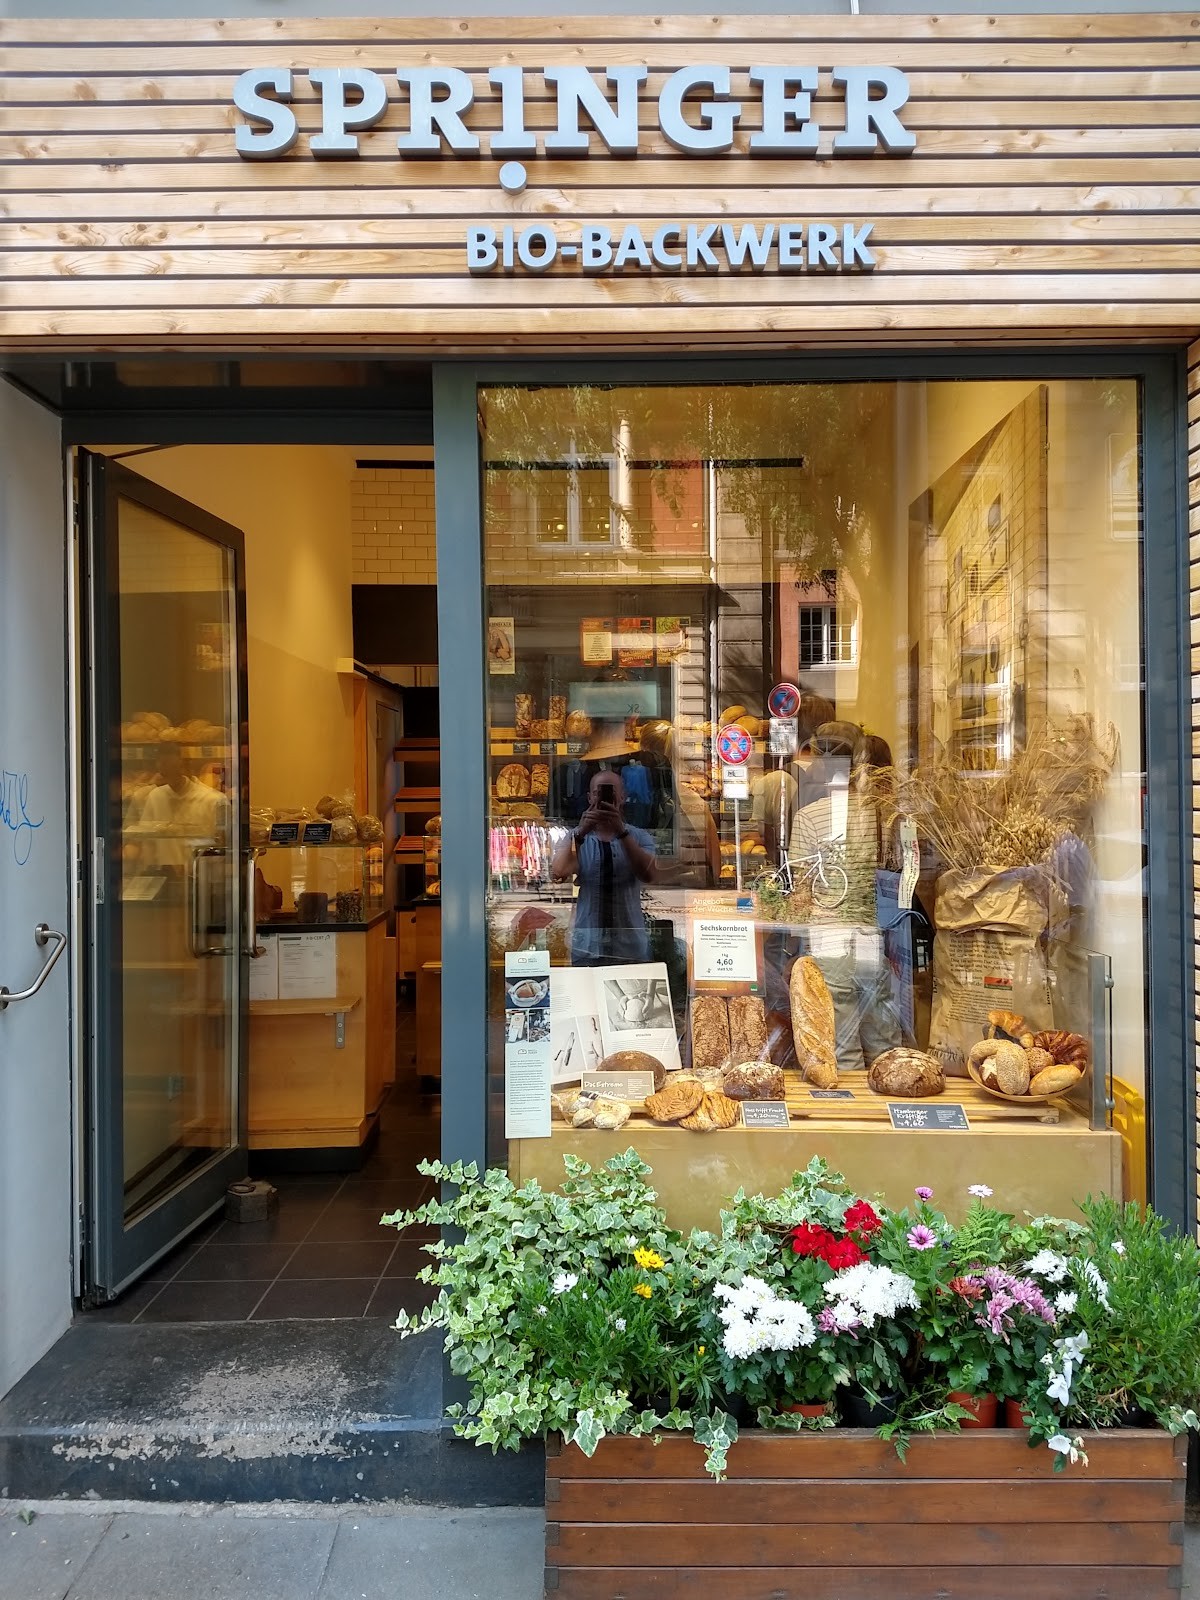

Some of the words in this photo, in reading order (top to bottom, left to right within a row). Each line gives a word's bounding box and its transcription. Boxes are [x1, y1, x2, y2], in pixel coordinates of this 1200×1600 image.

[232, 64, 918, 160] SPRINGER
[465, 221, 876, 274] BIO-BACKWERK
[716, 958, 734, 966] 4,60
[893, 1107, 929, 1115] Hamburger
